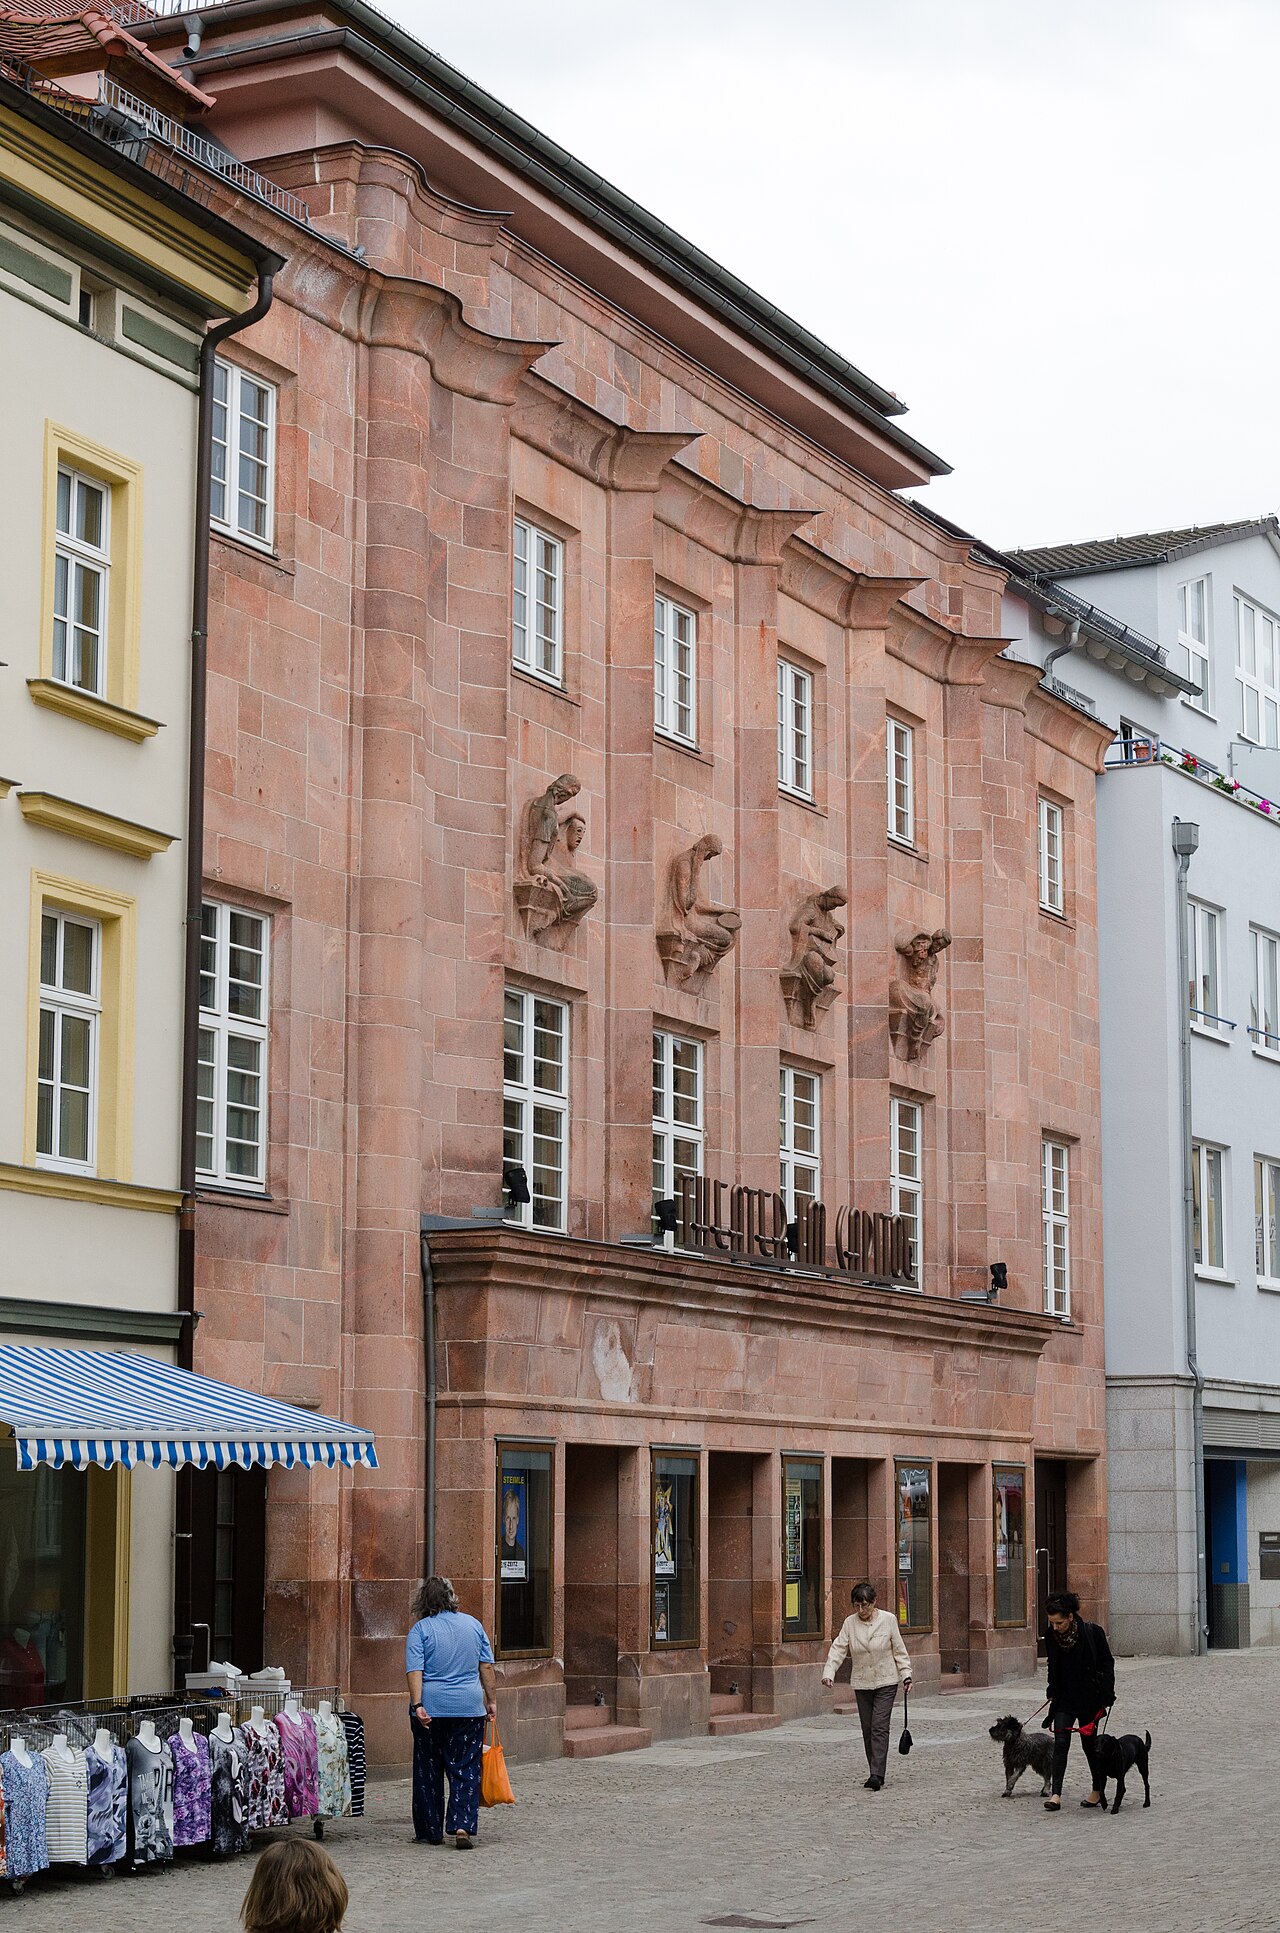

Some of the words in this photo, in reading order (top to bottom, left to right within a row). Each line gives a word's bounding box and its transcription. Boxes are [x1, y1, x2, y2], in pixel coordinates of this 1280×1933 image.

[678, 1172, 790, 1260] THEATER
[796, 1196, 826, 1267] IM
[835, 1204, 916, 1281] CAPITOL
